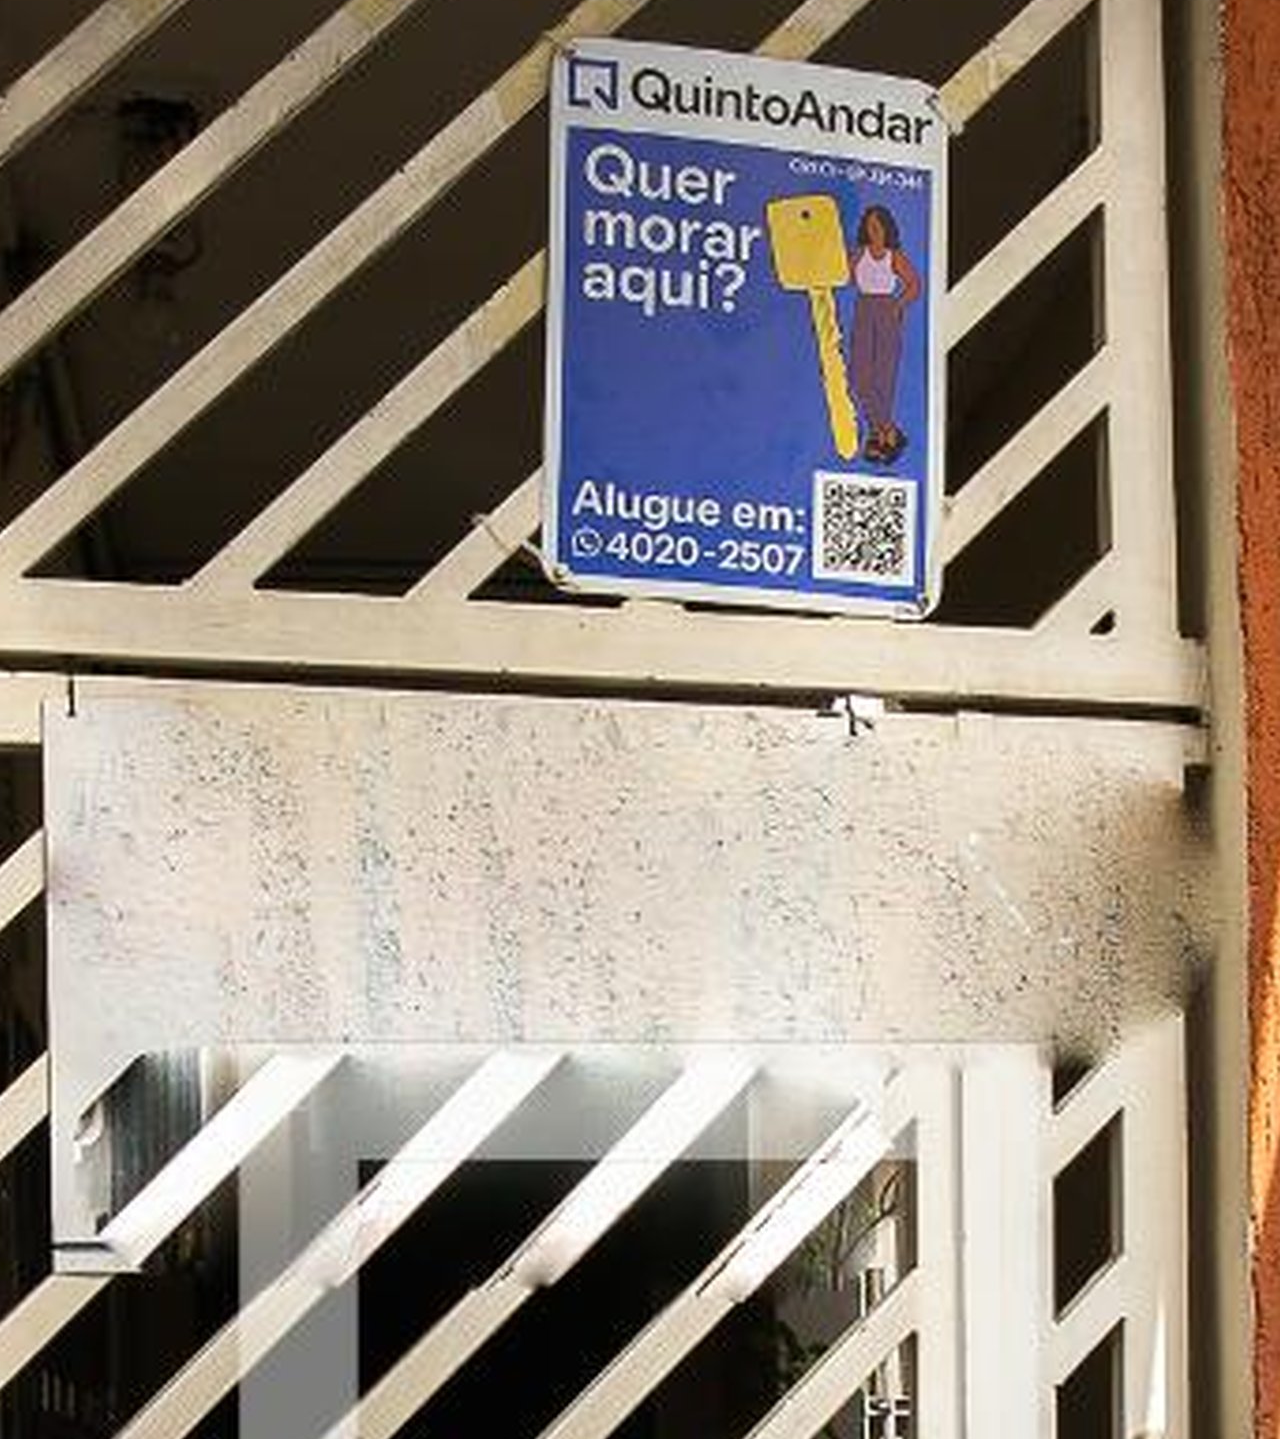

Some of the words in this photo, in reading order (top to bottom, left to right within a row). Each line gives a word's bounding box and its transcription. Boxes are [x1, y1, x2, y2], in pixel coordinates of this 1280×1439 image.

[630, 67, 933, 144] QuintoAndar
[584, 143, 736, 206] Quer
[582, 203, 763, 262] morar
[581, 261, 747, 315] aqui?
[572, 479, 721, 531] Alugue
[732, 500, 806, 534] em:
[605, 532, 806, 575] 4020-2507
